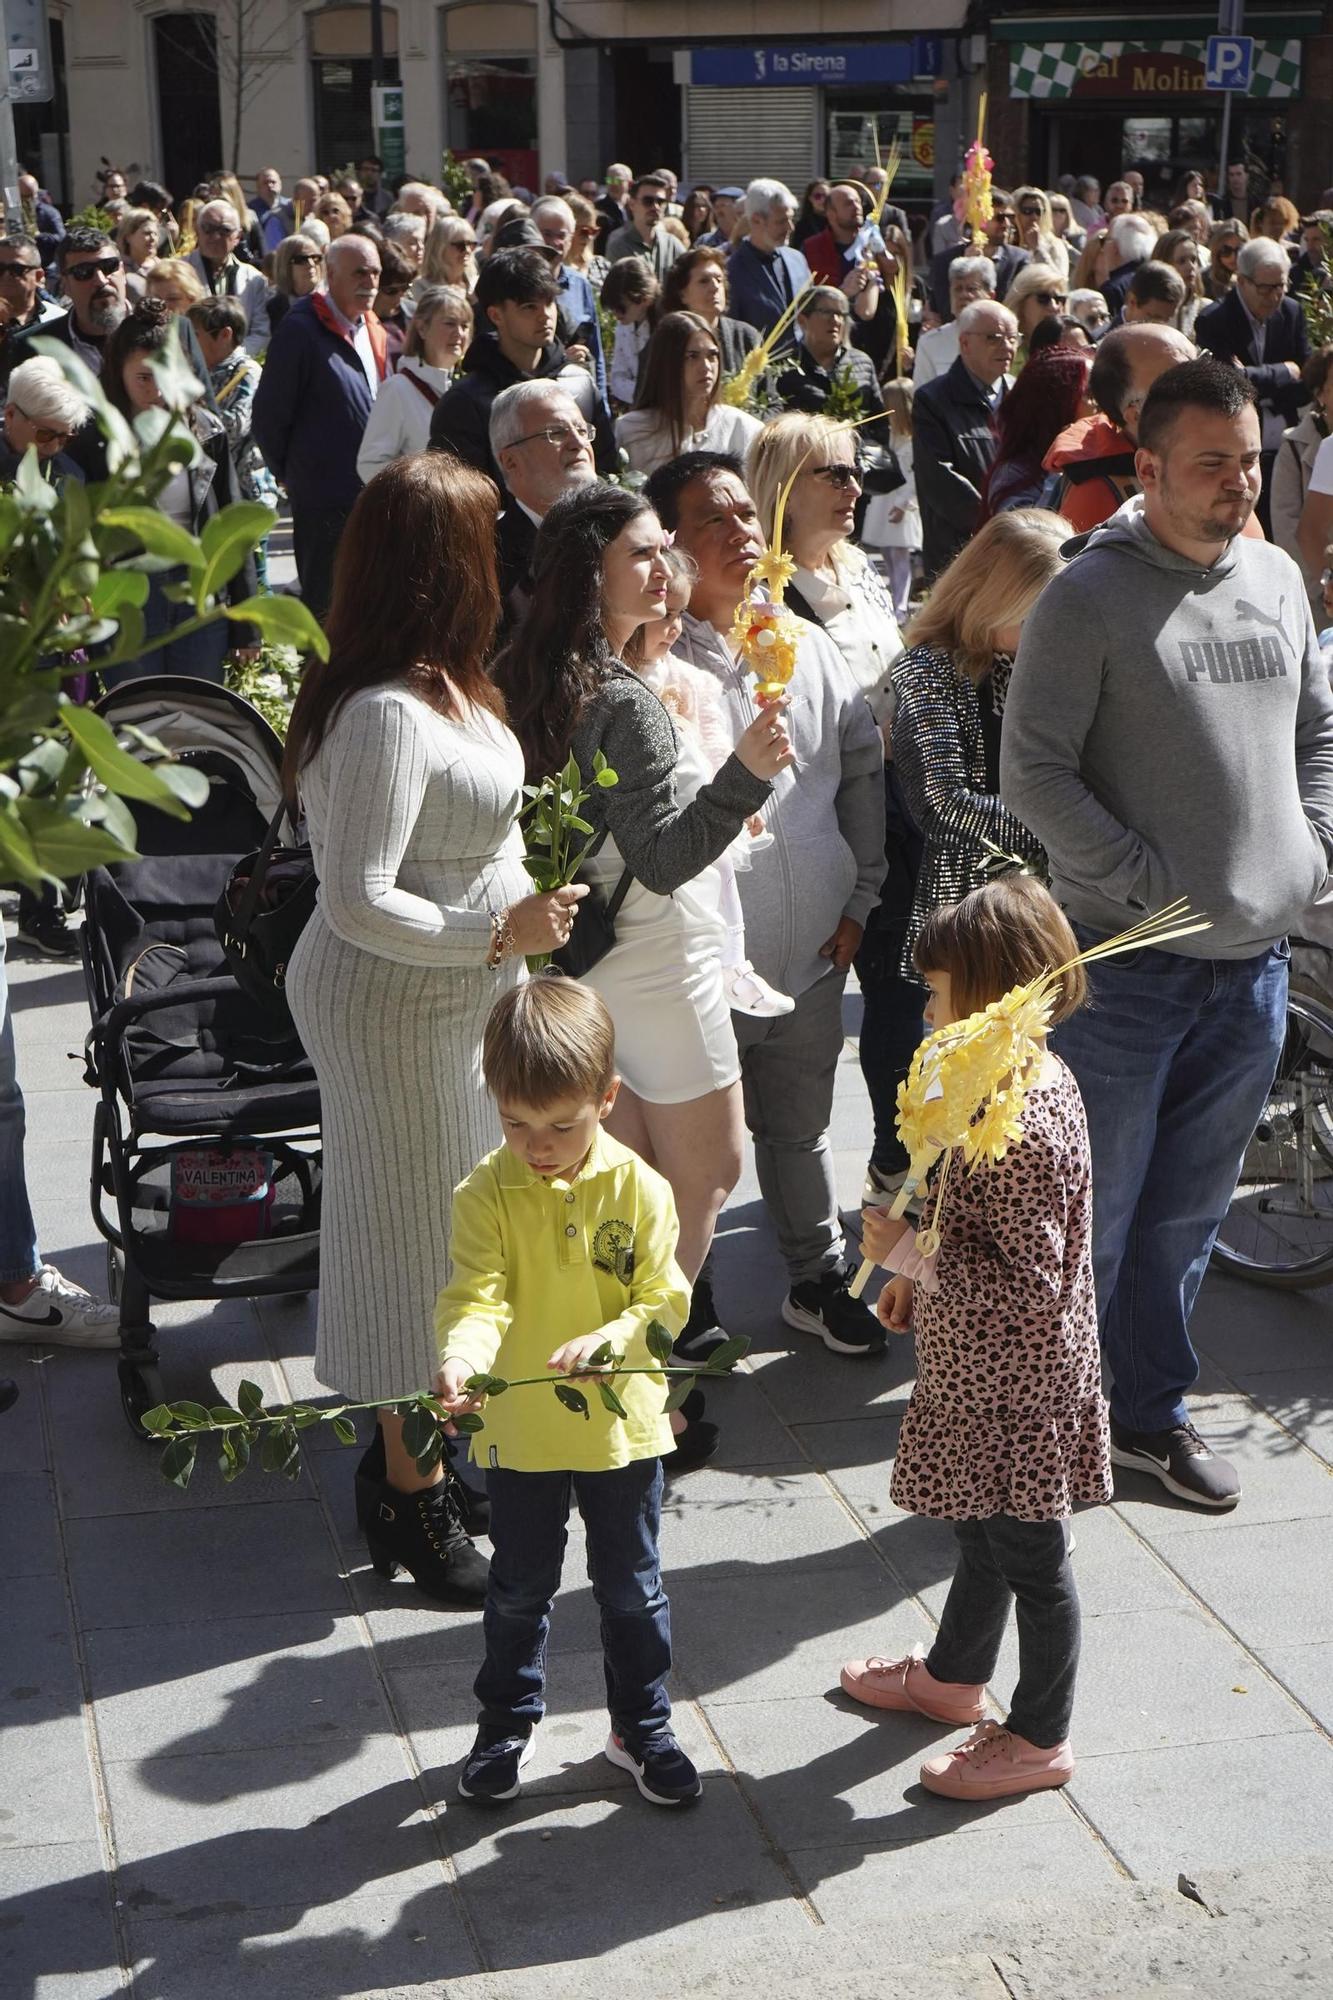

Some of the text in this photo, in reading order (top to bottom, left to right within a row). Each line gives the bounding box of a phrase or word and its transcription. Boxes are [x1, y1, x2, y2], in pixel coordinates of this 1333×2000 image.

[773, 52, 847, 72] la Sirena
[1082, 53, 1207, 91] Cal Molin
[1214, 41, 1243, 83] P
[1178, 635, 1287, 684] PUMA
[183, 1169, 257, 1186] VALENTINA
